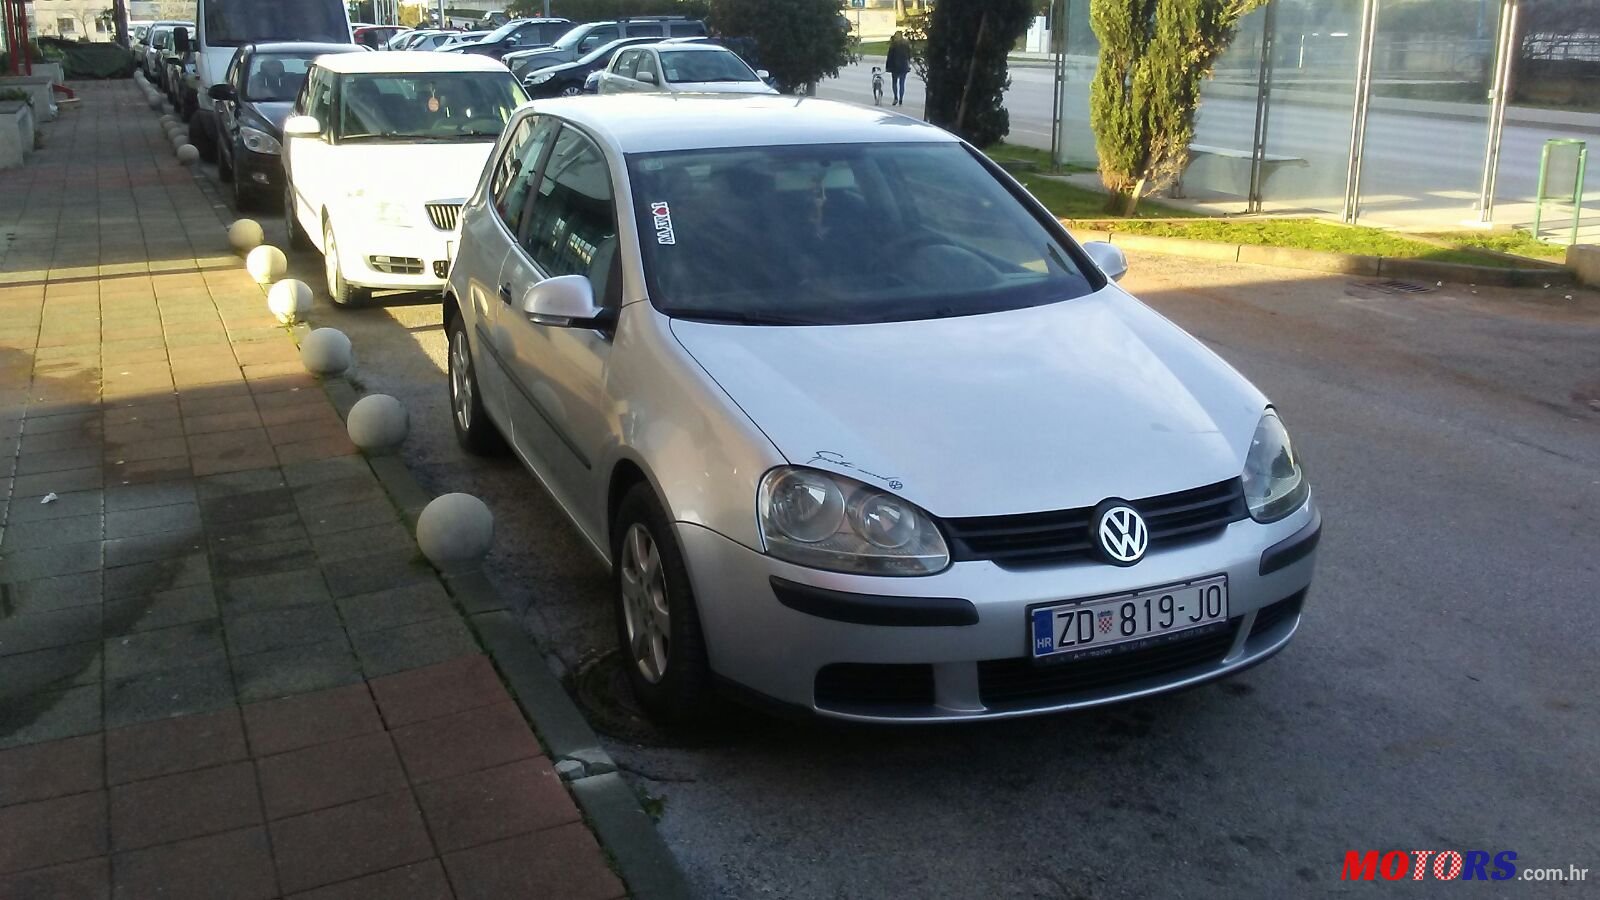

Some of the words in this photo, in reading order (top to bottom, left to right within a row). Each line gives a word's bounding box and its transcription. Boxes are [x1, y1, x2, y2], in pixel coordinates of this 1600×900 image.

[654, 215, 672, 230] MY
[657, 229, 676, 244] VW
[1100, 506, 1148, 562] VW
[1057, 609, 1095, 648] ZD
[1120, 585, 1222, 636] 819-JO
[1037, 637, 1052, 650] HR
